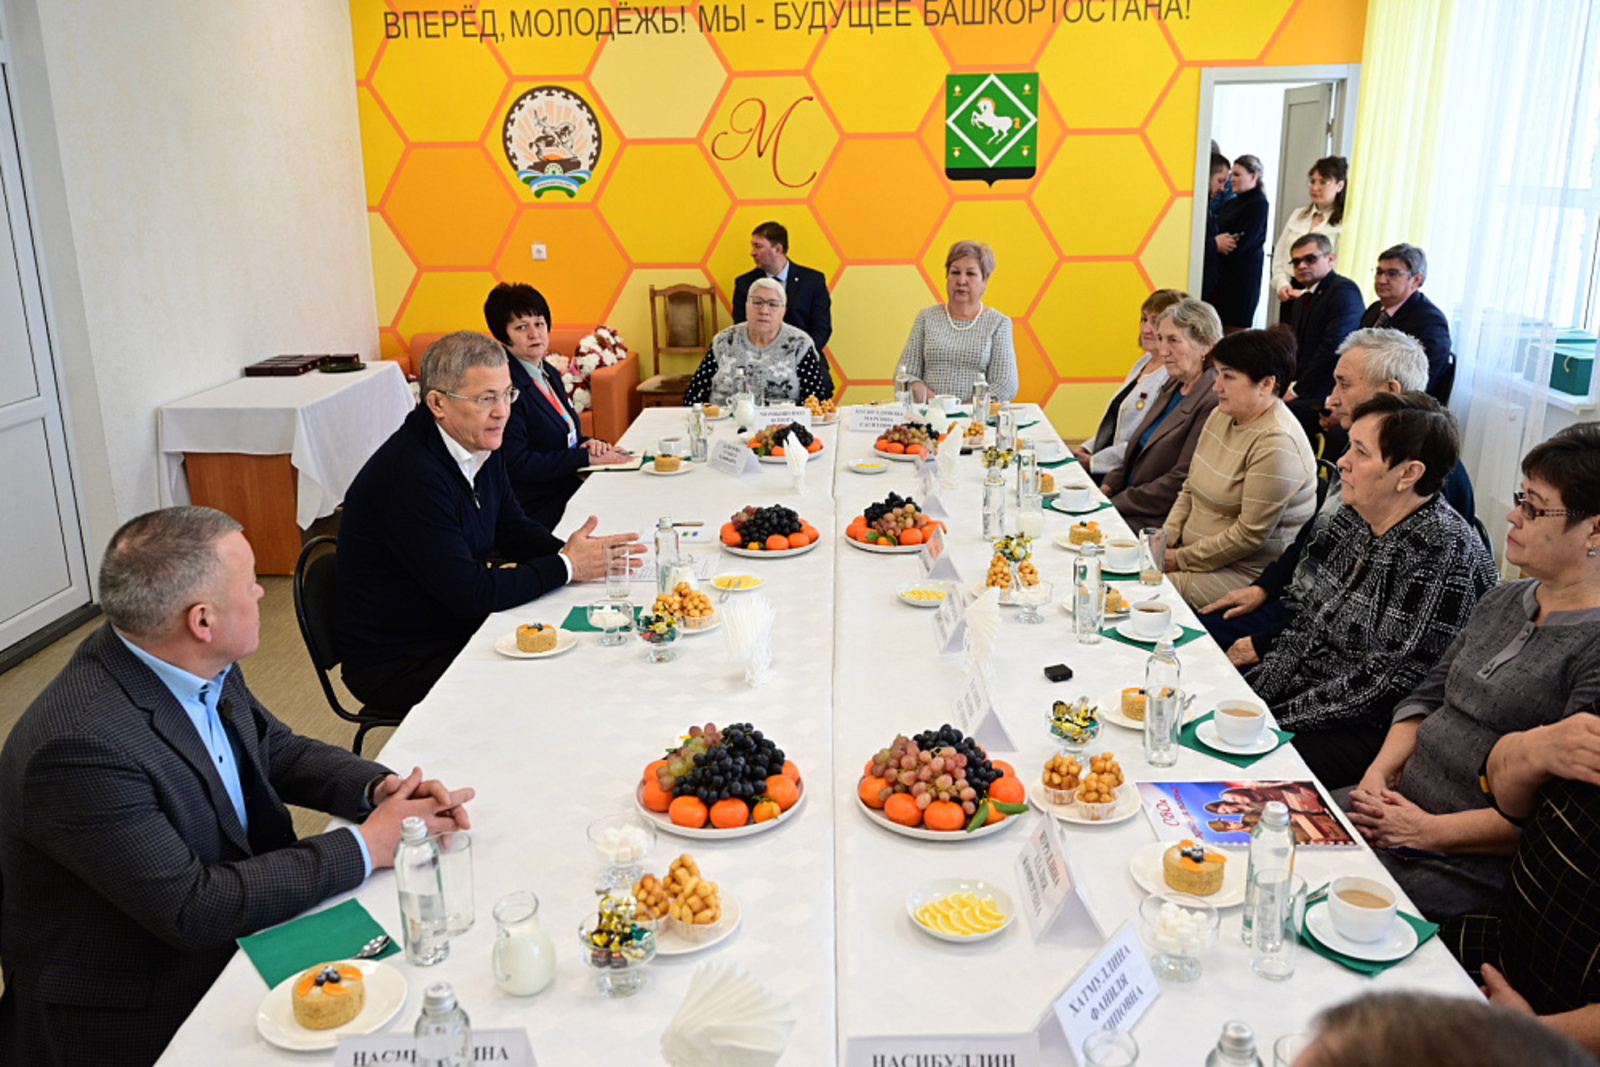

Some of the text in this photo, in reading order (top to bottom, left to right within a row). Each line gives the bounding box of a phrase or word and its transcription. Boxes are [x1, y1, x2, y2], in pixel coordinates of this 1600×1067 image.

[384, 5, 505, 43] ВПЕРЁД,
[510, 2, 686, 41] МОЛОДЁЖЬ!
[699, 4, 746, 32] МЫ
[774, 0, 911, 35] БУДУЩЕЕ
[923, 0, 1191, 26] БАШКОРТОСТАНА!
[1068, 944, 1131, 1018] ХАТМУЛЛИНА
[1091, 972, 1129, 1021] ФАНИЛЯ
[872, 1054, 1016, 1067] НАСИБУЛЛИН
